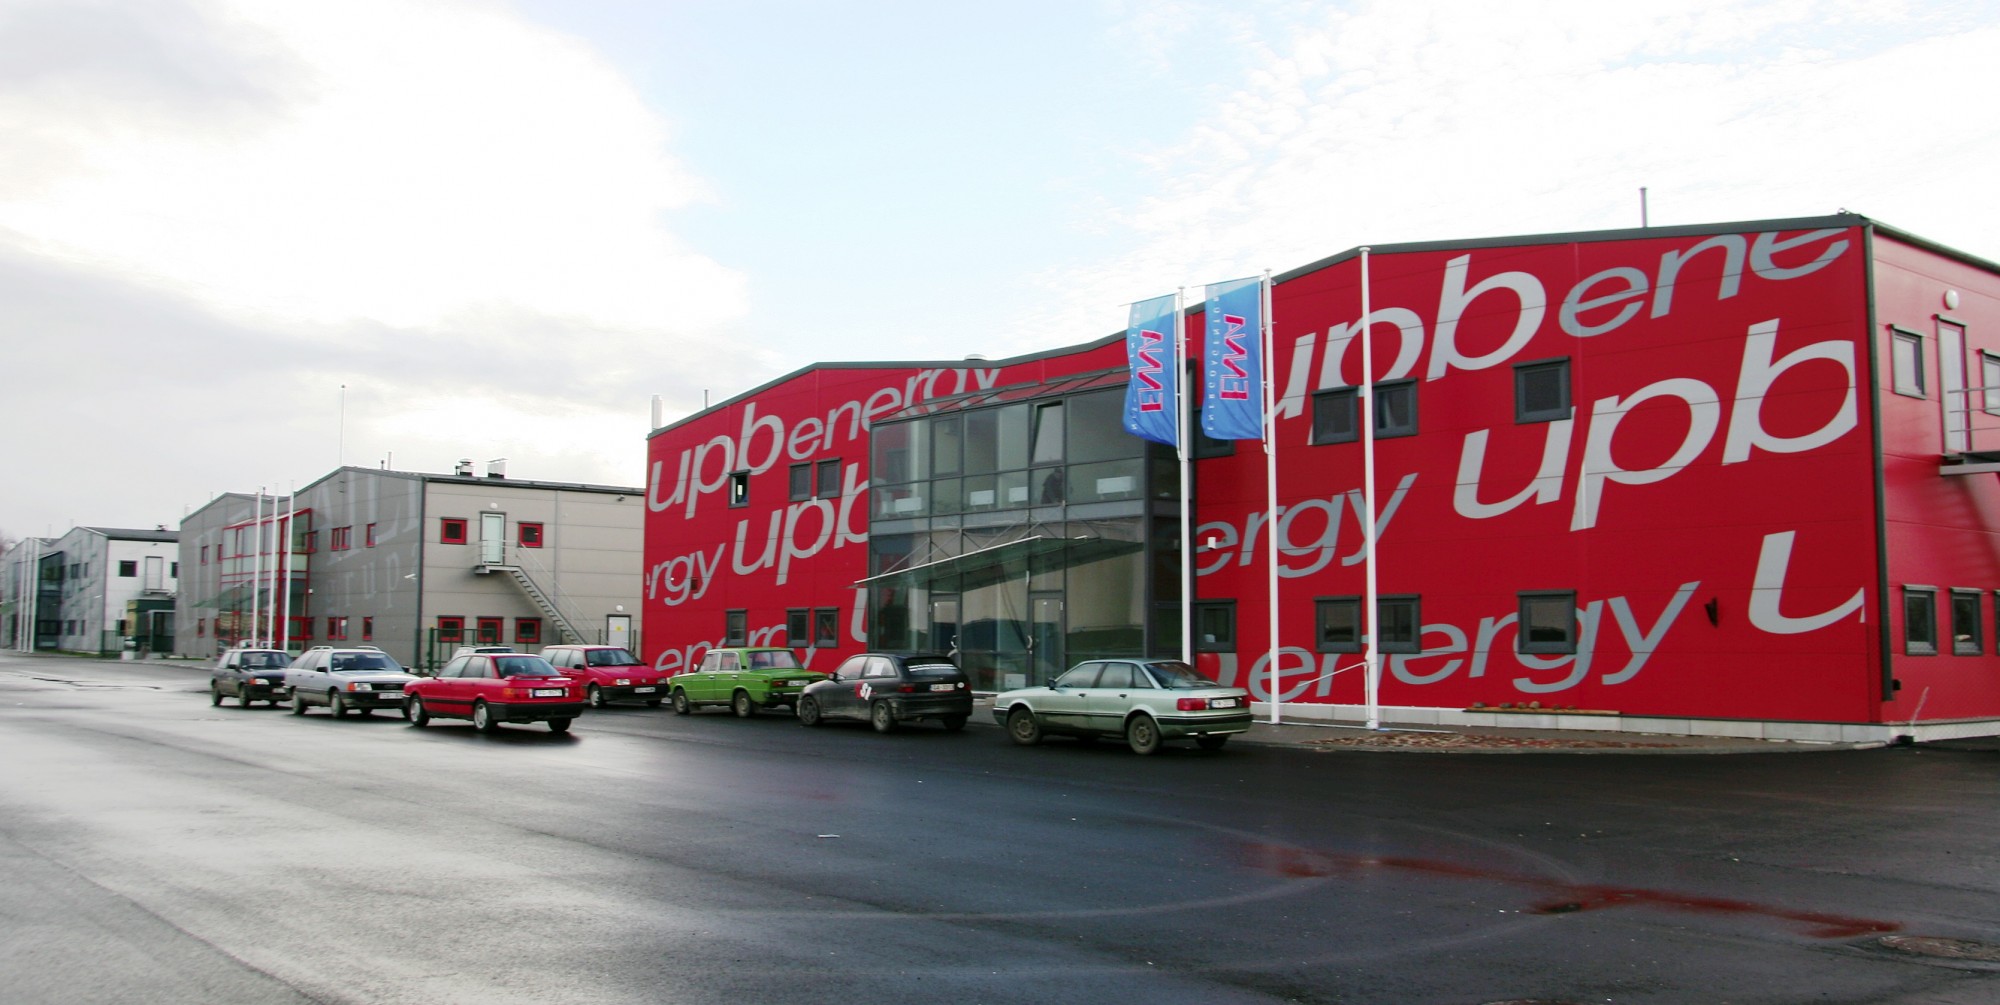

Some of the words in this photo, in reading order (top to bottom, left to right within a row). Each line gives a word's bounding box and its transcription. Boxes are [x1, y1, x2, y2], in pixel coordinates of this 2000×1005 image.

[648, 402, 785, 520] upb
[1452, 318, 1858, 532] upb
[645, 543, 726, 606] rgy
[732, 462, 868, 586] upb
